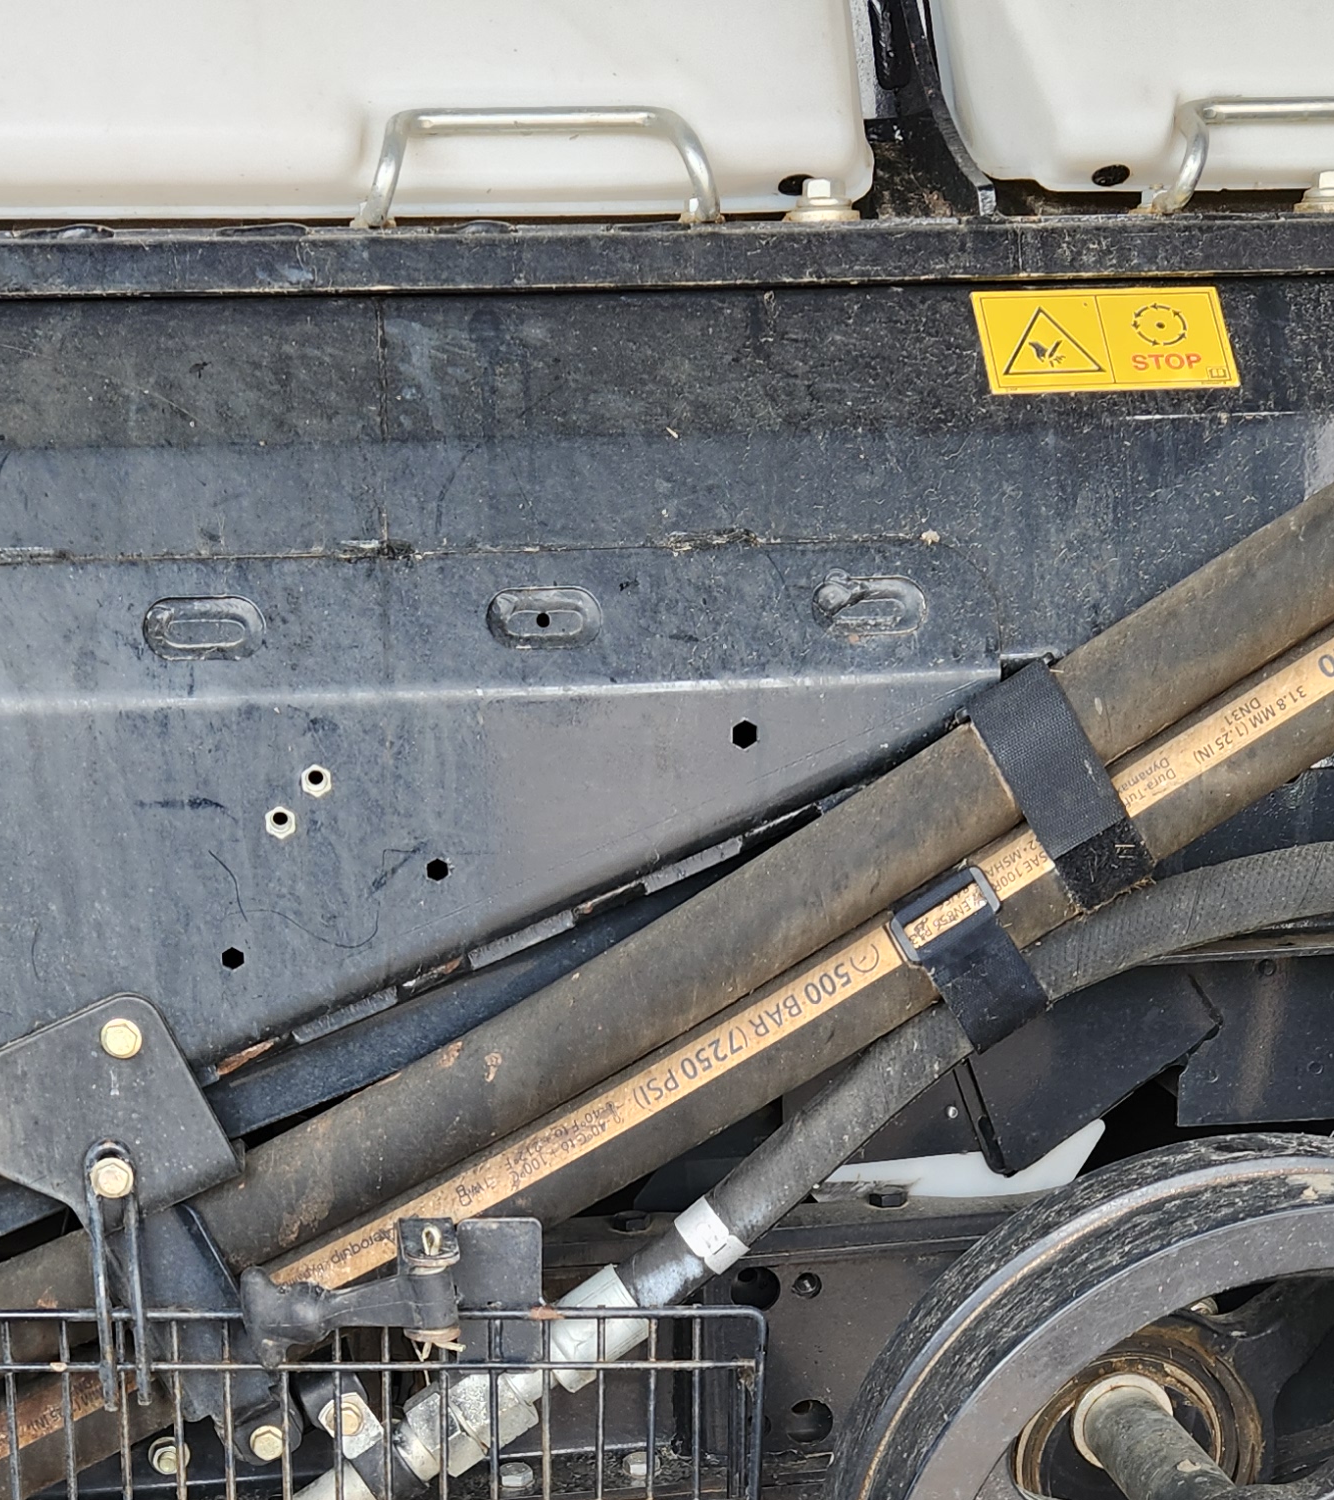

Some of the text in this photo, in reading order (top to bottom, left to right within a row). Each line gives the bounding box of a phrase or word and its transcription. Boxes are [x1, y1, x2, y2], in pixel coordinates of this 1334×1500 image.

[1131, 353, 1203, 371] STOP
[1190, 684, 1308, 765] 31.8 MM (1.25 IN)
[1222, 695, 1262, 726] DN31
[1020, 849, 1049, 873] SAE
[629, 961, 854, 1110] 500 BAR (7250 PSI)
[329, 1223, 399, 1268] Aeroquip
